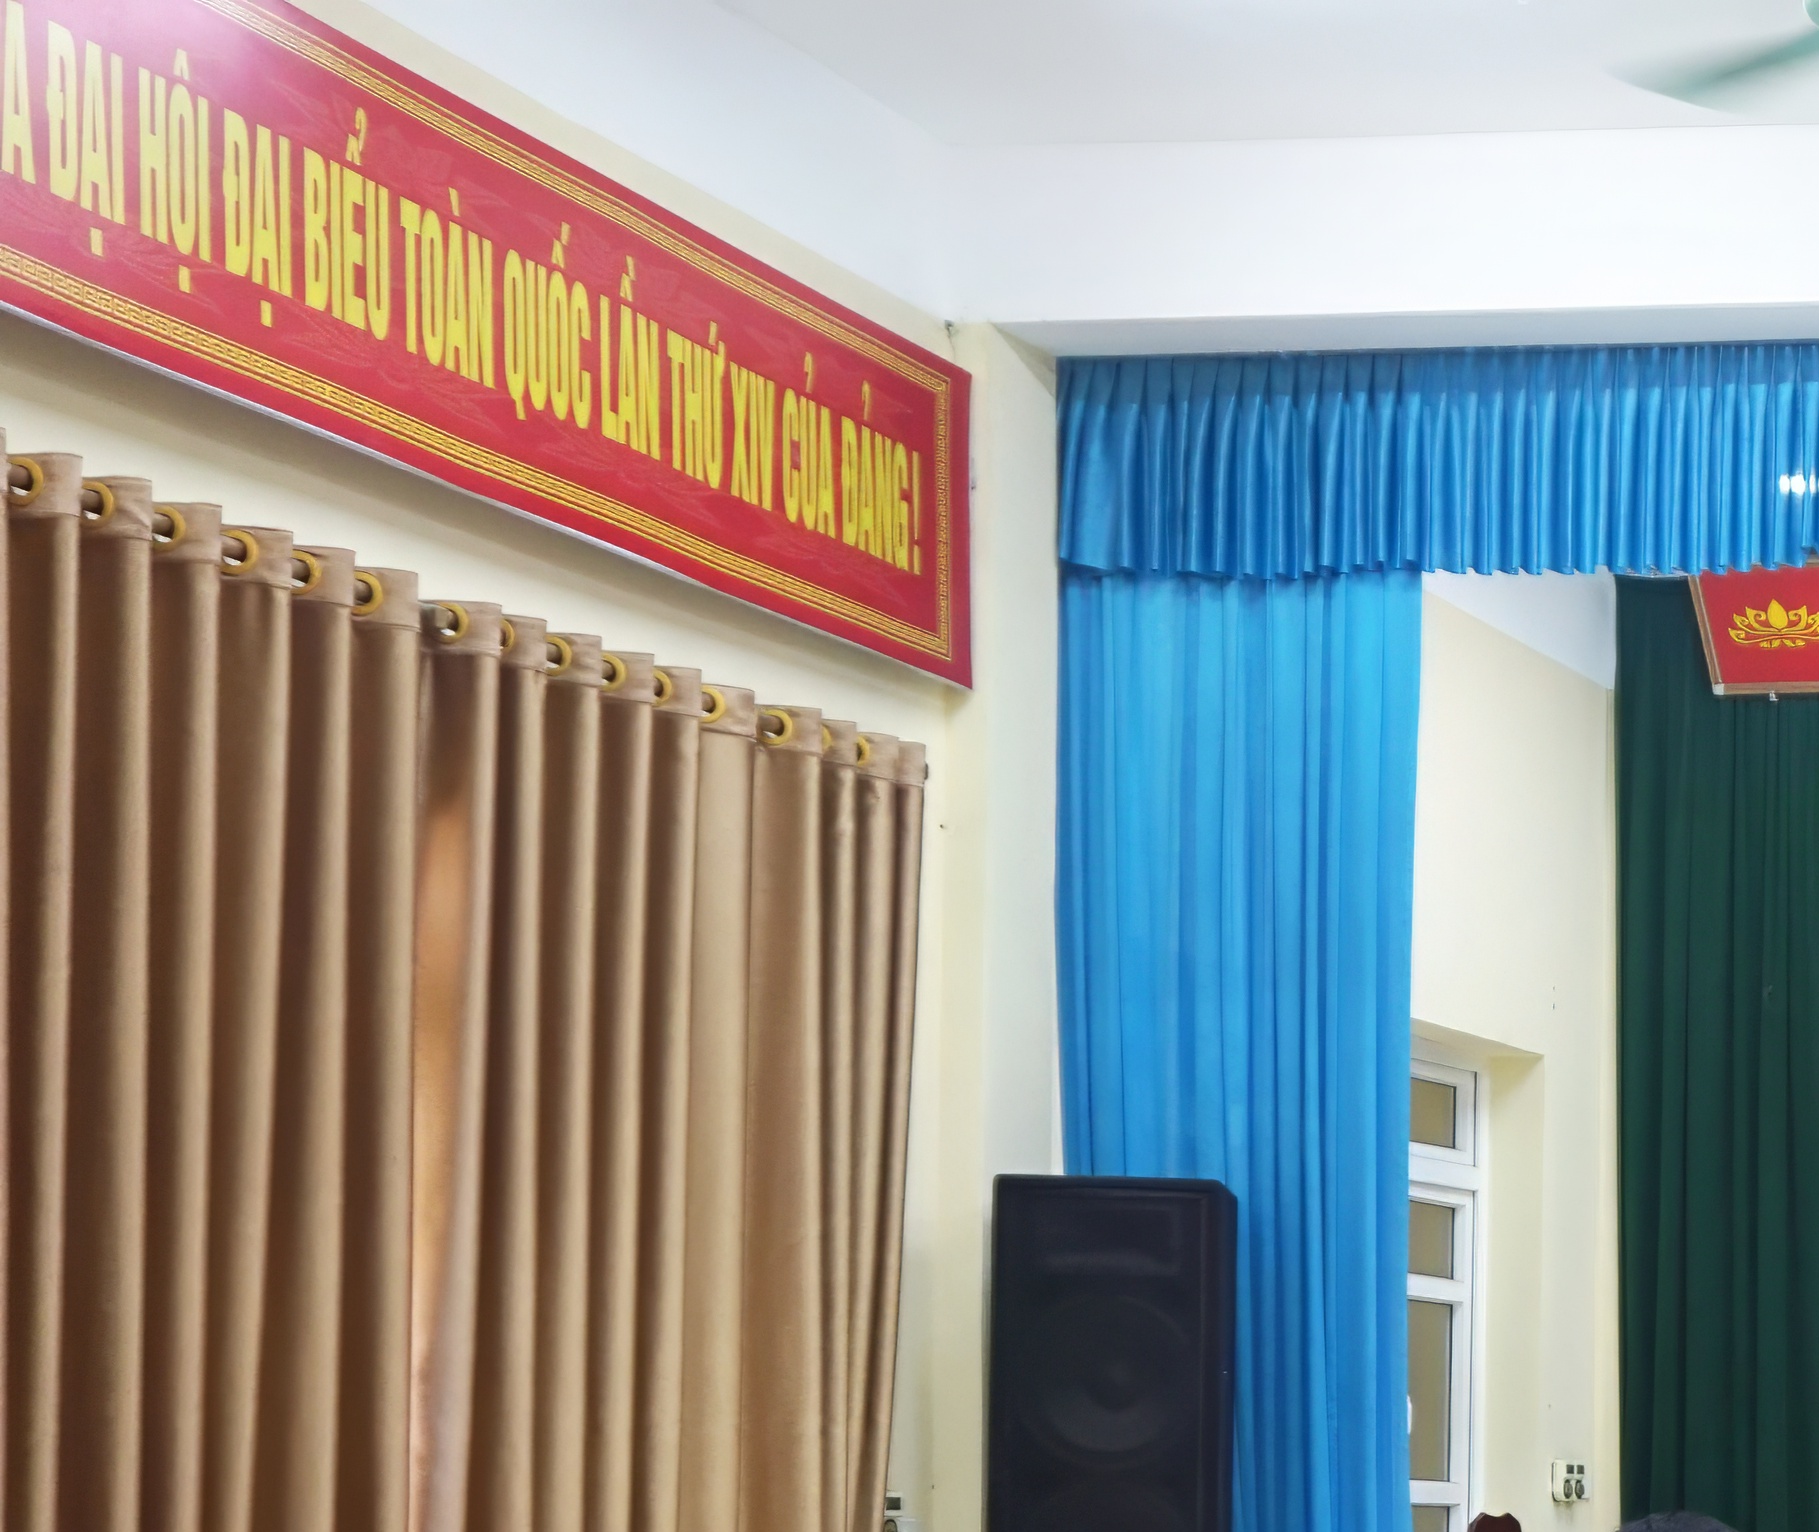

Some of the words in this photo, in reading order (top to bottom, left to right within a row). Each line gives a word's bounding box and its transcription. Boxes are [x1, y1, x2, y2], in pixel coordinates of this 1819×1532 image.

[46, 19, 126, 256] ĐẠI
[138, 50, 212, 293] HỘI
[222, 109, 293, 327] ĐẠI
[302, 107, 390, 342] BIỂU
[400, 188, 495, 388] TOÀN
[503, 222, 591, 430] QUỐC
[599, 254, 662, 461] LẦN
[667, 320, 727, 491] THỨ
[729, 361, 776, 513] XIV
[782, 352, 837, 535] CỦA
